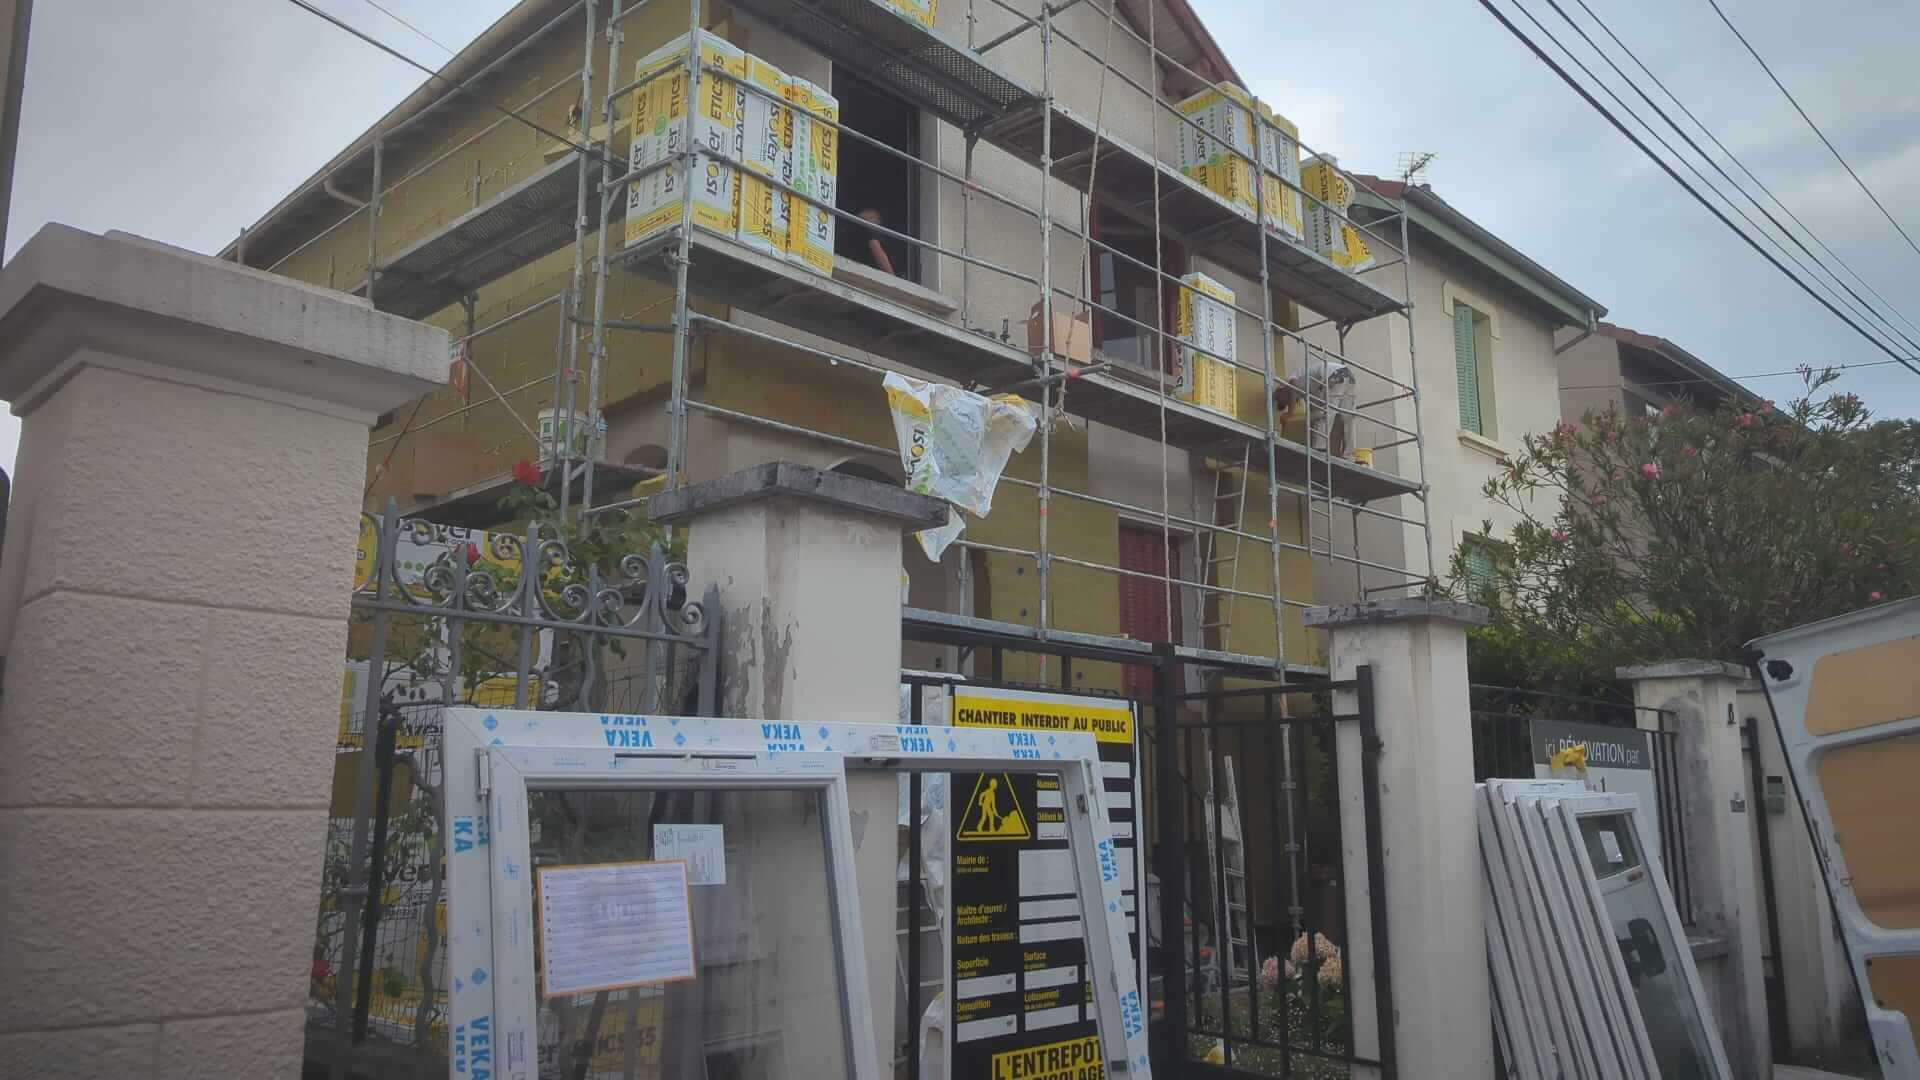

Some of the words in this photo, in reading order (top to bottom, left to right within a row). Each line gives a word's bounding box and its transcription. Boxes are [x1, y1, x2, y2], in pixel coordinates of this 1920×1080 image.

[958, 708, 1017, 727] CHANTIER
[1021, 712, 1069, 729] INTERDIT
[1073, 718, 1088, 731] AU
[1092, 719, 1126, 733] PUBLIC
[604, 729, 654, 748] VEKA
[761, 723, 803, 741] VEKA
[1007, 732, 1038, 747] VEKA
[899, 737, 935, 753] VEKA
[1626, 748, 1640, 767] par
[454, 815, 473, 854] KA
[1098, 839, 1114, 883] VEKA
[1127, 991, 1142, 1034] VEKA
